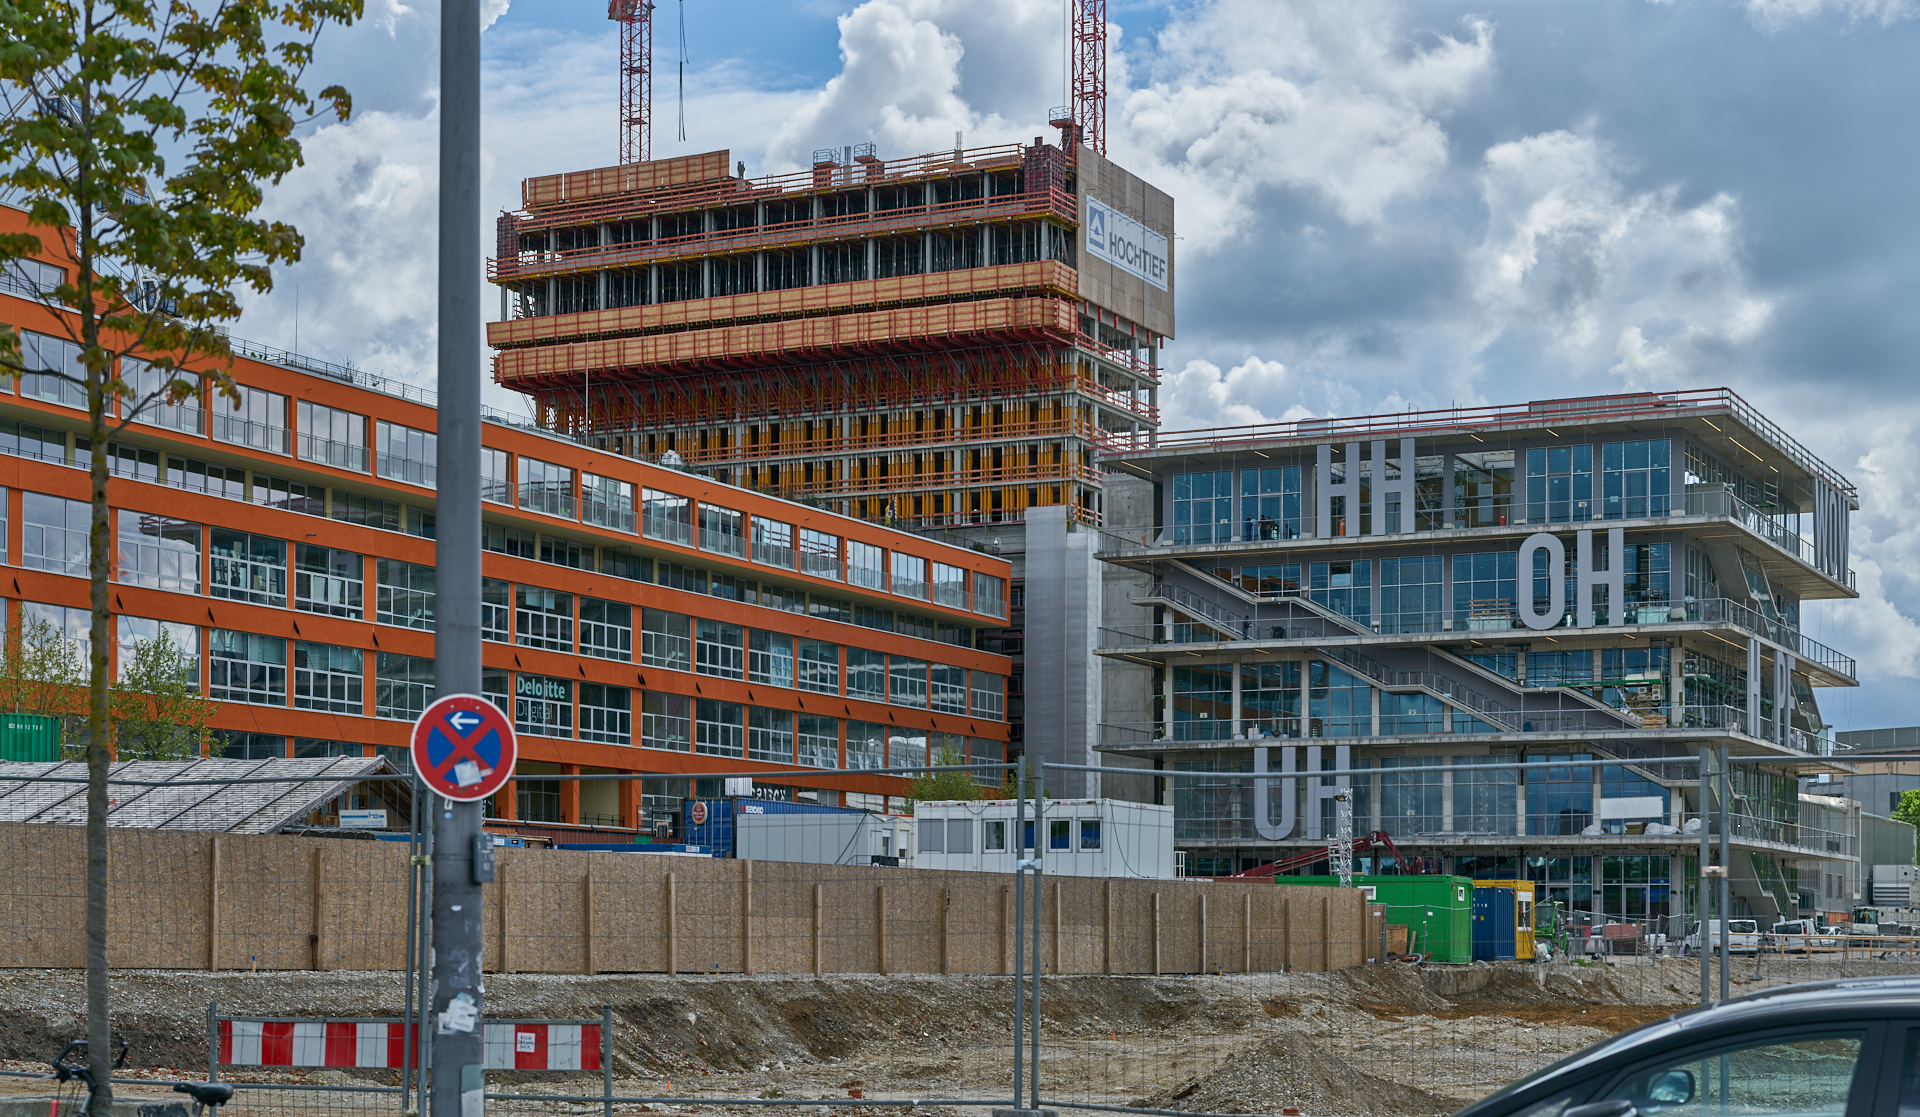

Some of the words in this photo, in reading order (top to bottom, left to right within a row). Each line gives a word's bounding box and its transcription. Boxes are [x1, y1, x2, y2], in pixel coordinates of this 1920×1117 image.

[1109, 232, 1166, 280] HOCHTIEF
[1812, 477, 1850, 585] WOW
[1519, 528, 1624, 630] OH
[517, 700, 553, 723] Digital
[1254, 746, 1350, 840] UH
